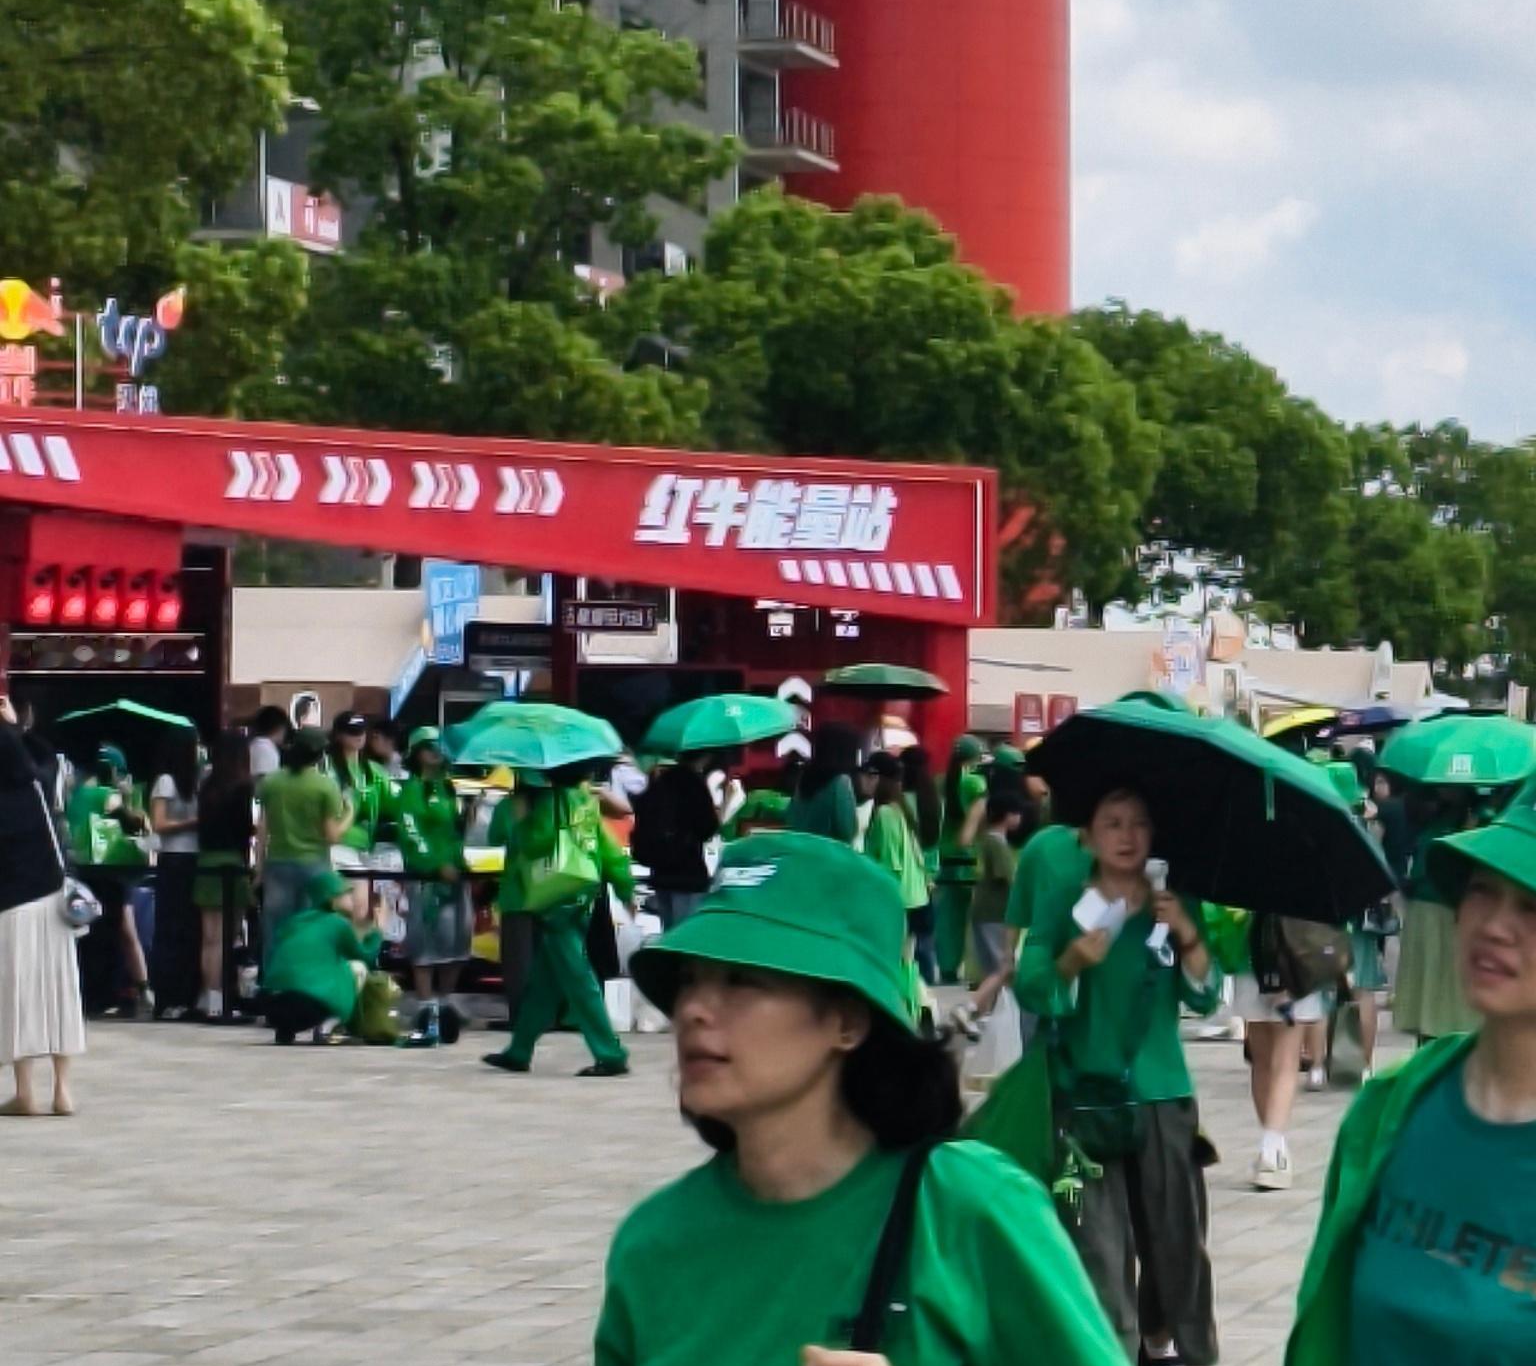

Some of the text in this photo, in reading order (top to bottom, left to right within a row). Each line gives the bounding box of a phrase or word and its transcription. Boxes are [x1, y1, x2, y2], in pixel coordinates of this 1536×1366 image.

[634, 474, 897, 552] 红牛能量站
